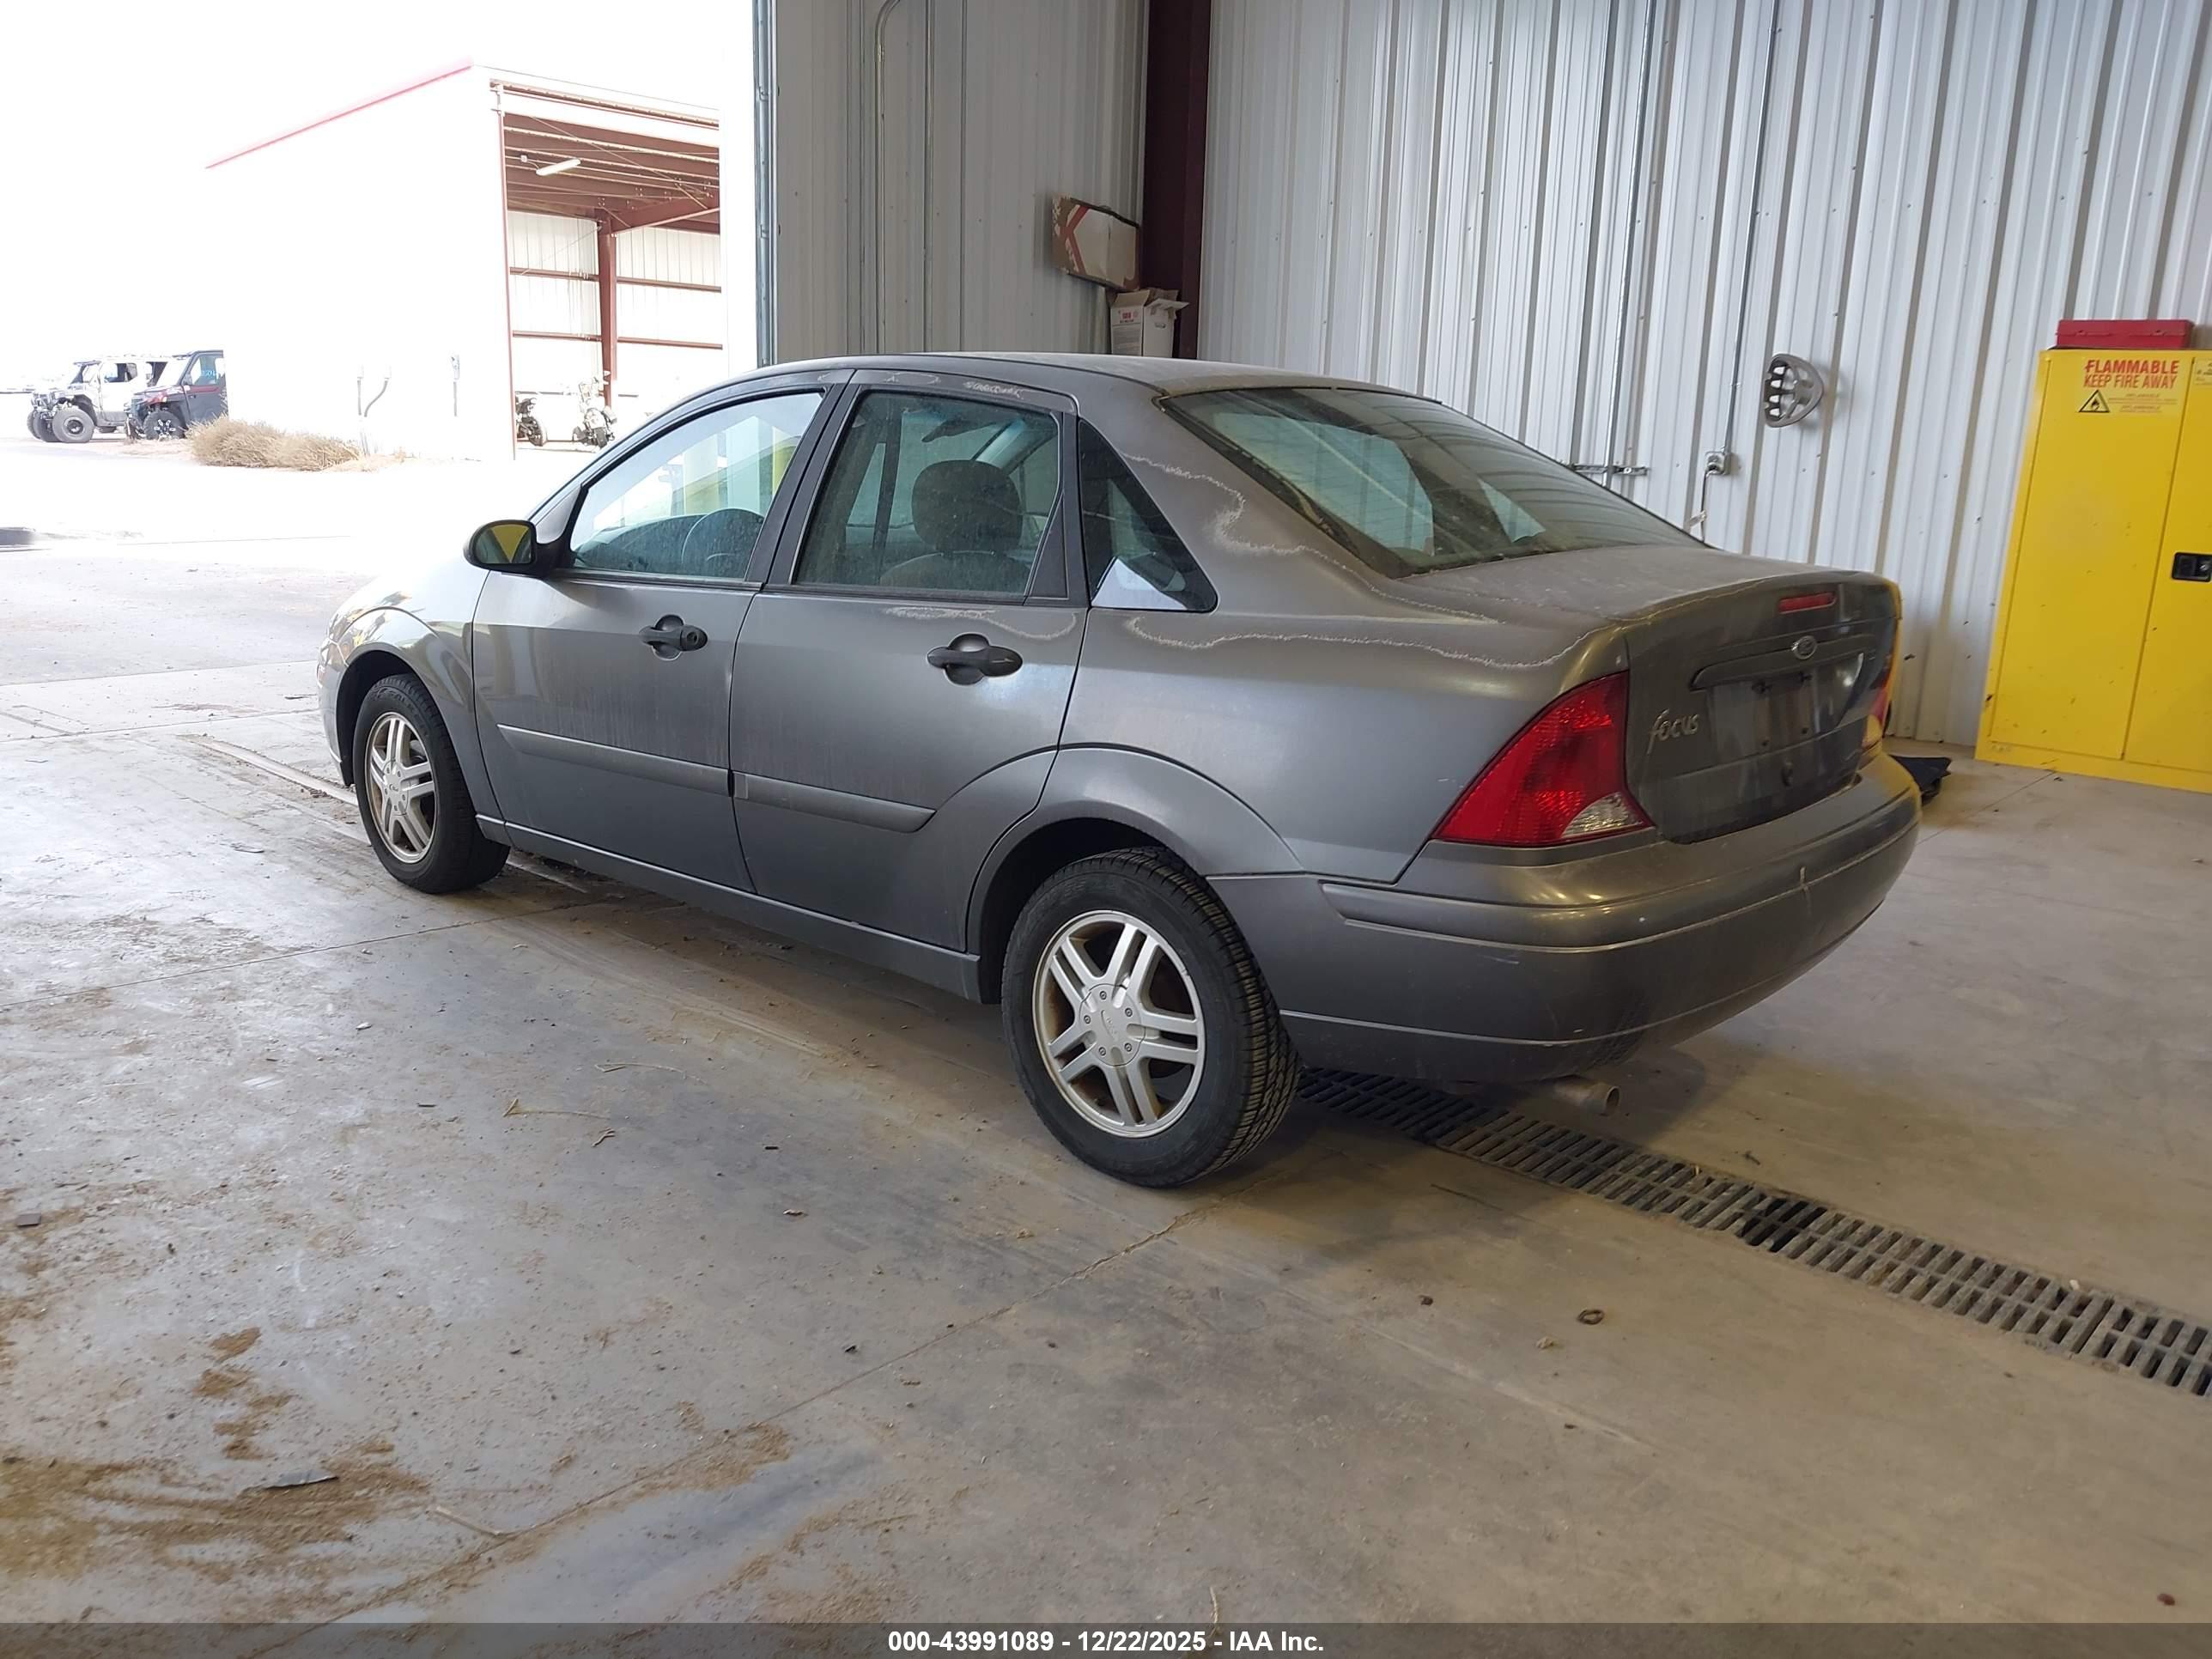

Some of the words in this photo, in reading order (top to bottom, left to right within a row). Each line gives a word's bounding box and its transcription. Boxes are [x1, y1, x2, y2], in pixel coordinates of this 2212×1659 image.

[2084, 359, 2179, 374] FLAMMABLE
[2082, 374, 2112, 388] KEEP
[2113, 374, 2139, 388] FIRE
[2142, 375, 2179, 389] AWAY
